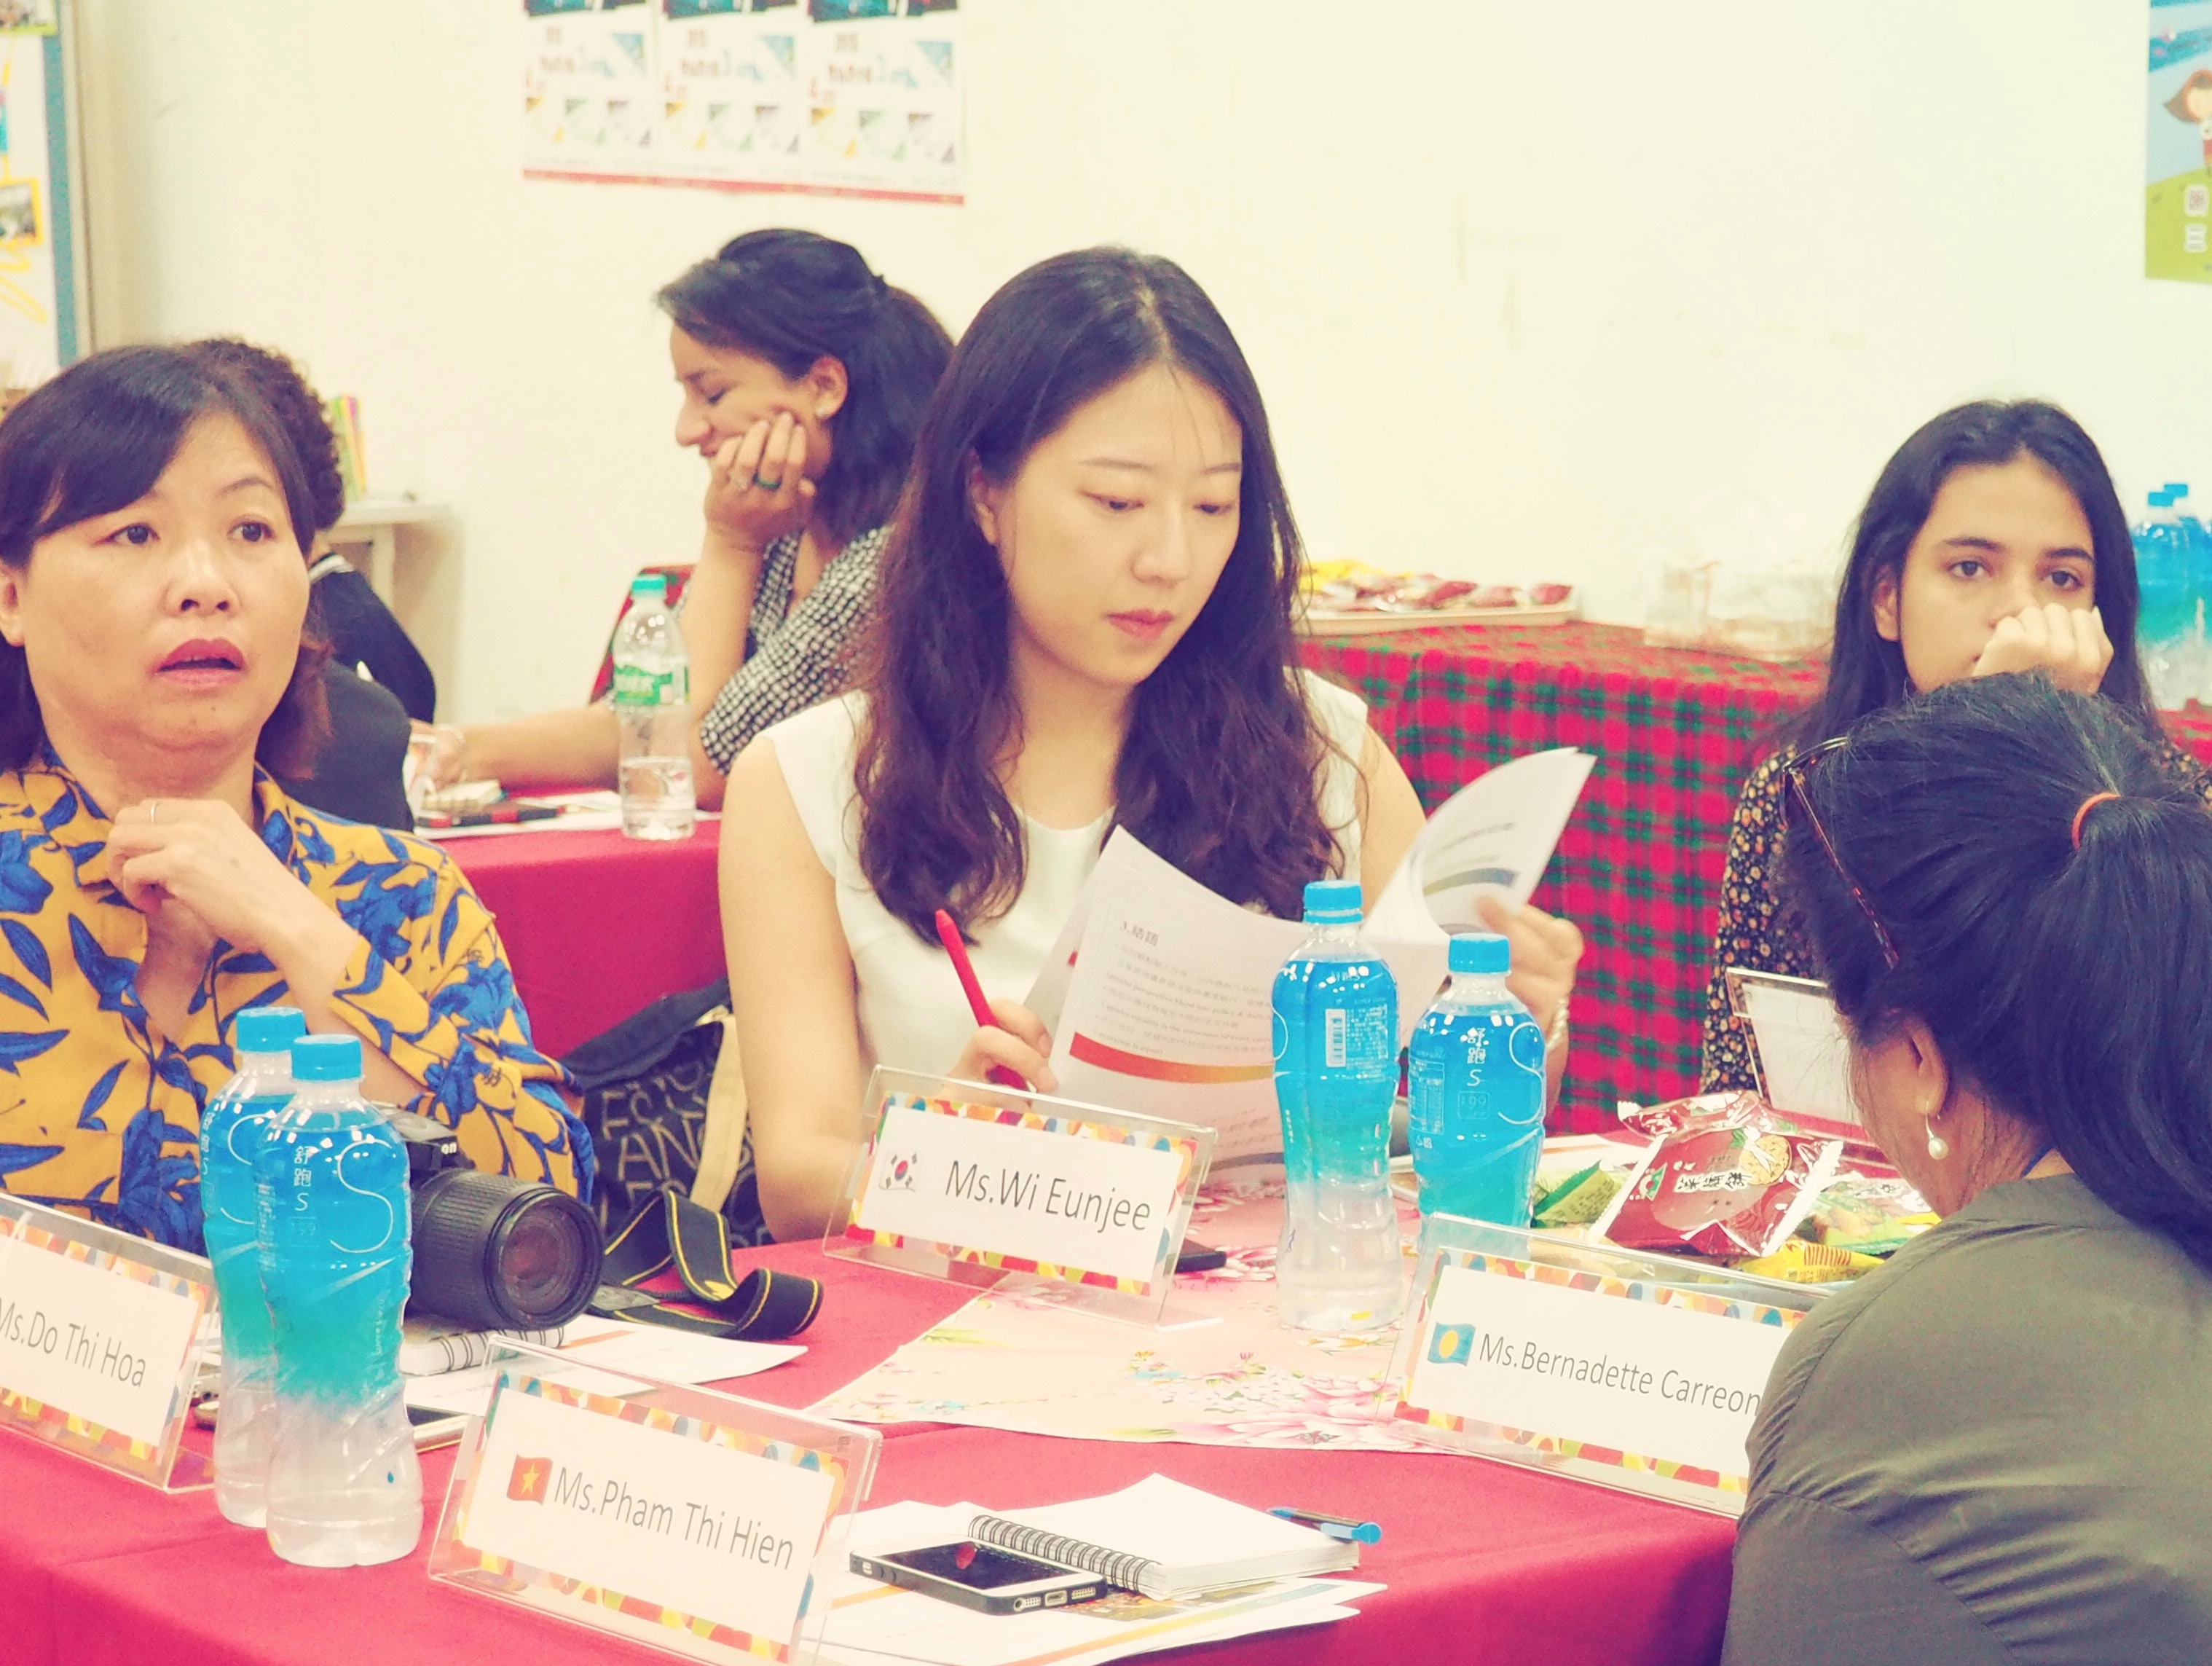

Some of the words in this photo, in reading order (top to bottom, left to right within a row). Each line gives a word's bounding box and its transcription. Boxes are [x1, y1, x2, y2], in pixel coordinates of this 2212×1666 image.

[945, 1160, 1039, 1211] Ms.Wi
[1045, 1177, 1152, 1234] Eunjee
[66, 1323, 100, 1370] Thi
[101, 1336, 146, 1388] Hoa
[1479, 1333, 1653, 1394] Ms.Bernadette
[1661, 1370, 1761, 1418] Carreon
[554, 1466, 674, 1536] Ms.Pham
[684, 1501, 726, 1550] Thi
[729, 1515, 794, 1571] Hien
